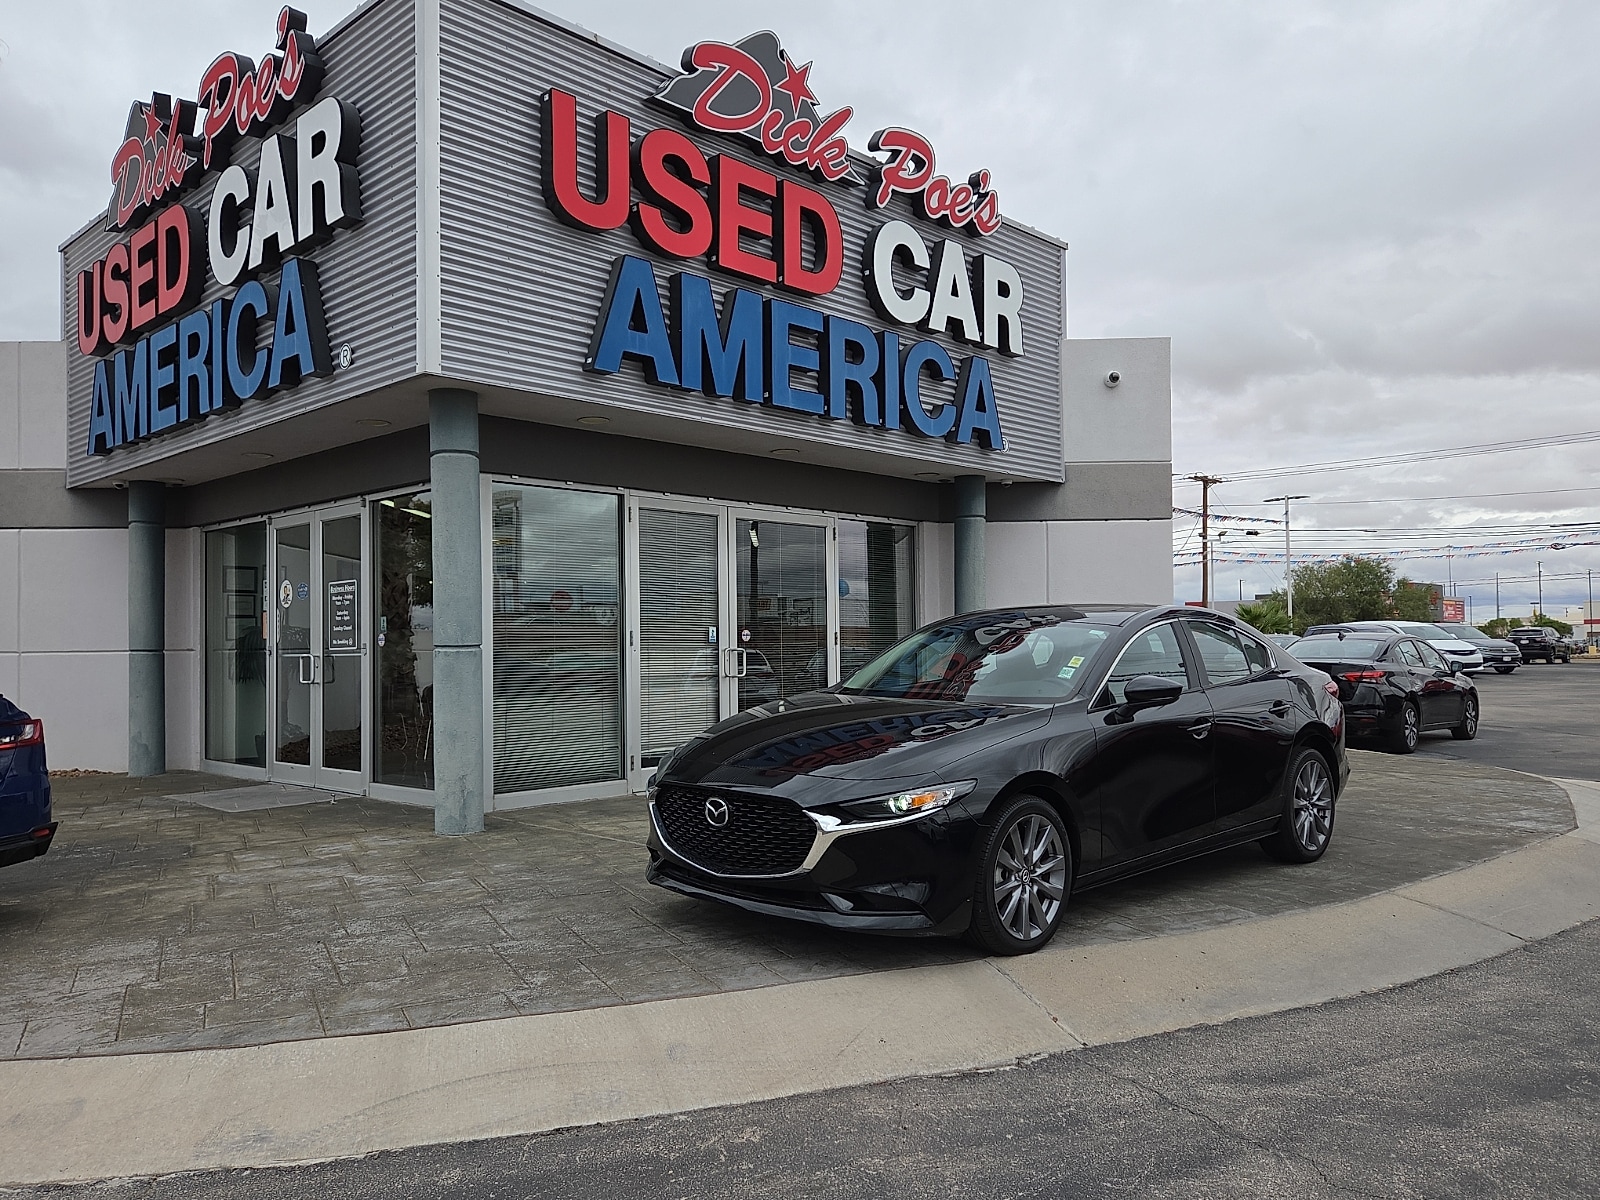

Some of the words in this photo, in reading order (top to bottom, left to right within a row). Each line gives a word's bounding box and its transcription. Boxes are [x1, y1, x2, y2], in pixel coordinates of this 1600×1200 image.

[111, 98, 190, 228] Dick
[198, 4, 306, 170] Poe's
[690, 40, 855, 182] Dick
[875, 127, 1002, 237] Poe's
[78, 204, 191, 356] USED
[208, 96, 344, 287] CAR
[549, 88, 844, 295] USED
[871, 219, 1025, 358] CAR
[87, 257, 316, 457] AMERICA
[592, 254, 1003, 451] AMERICA
